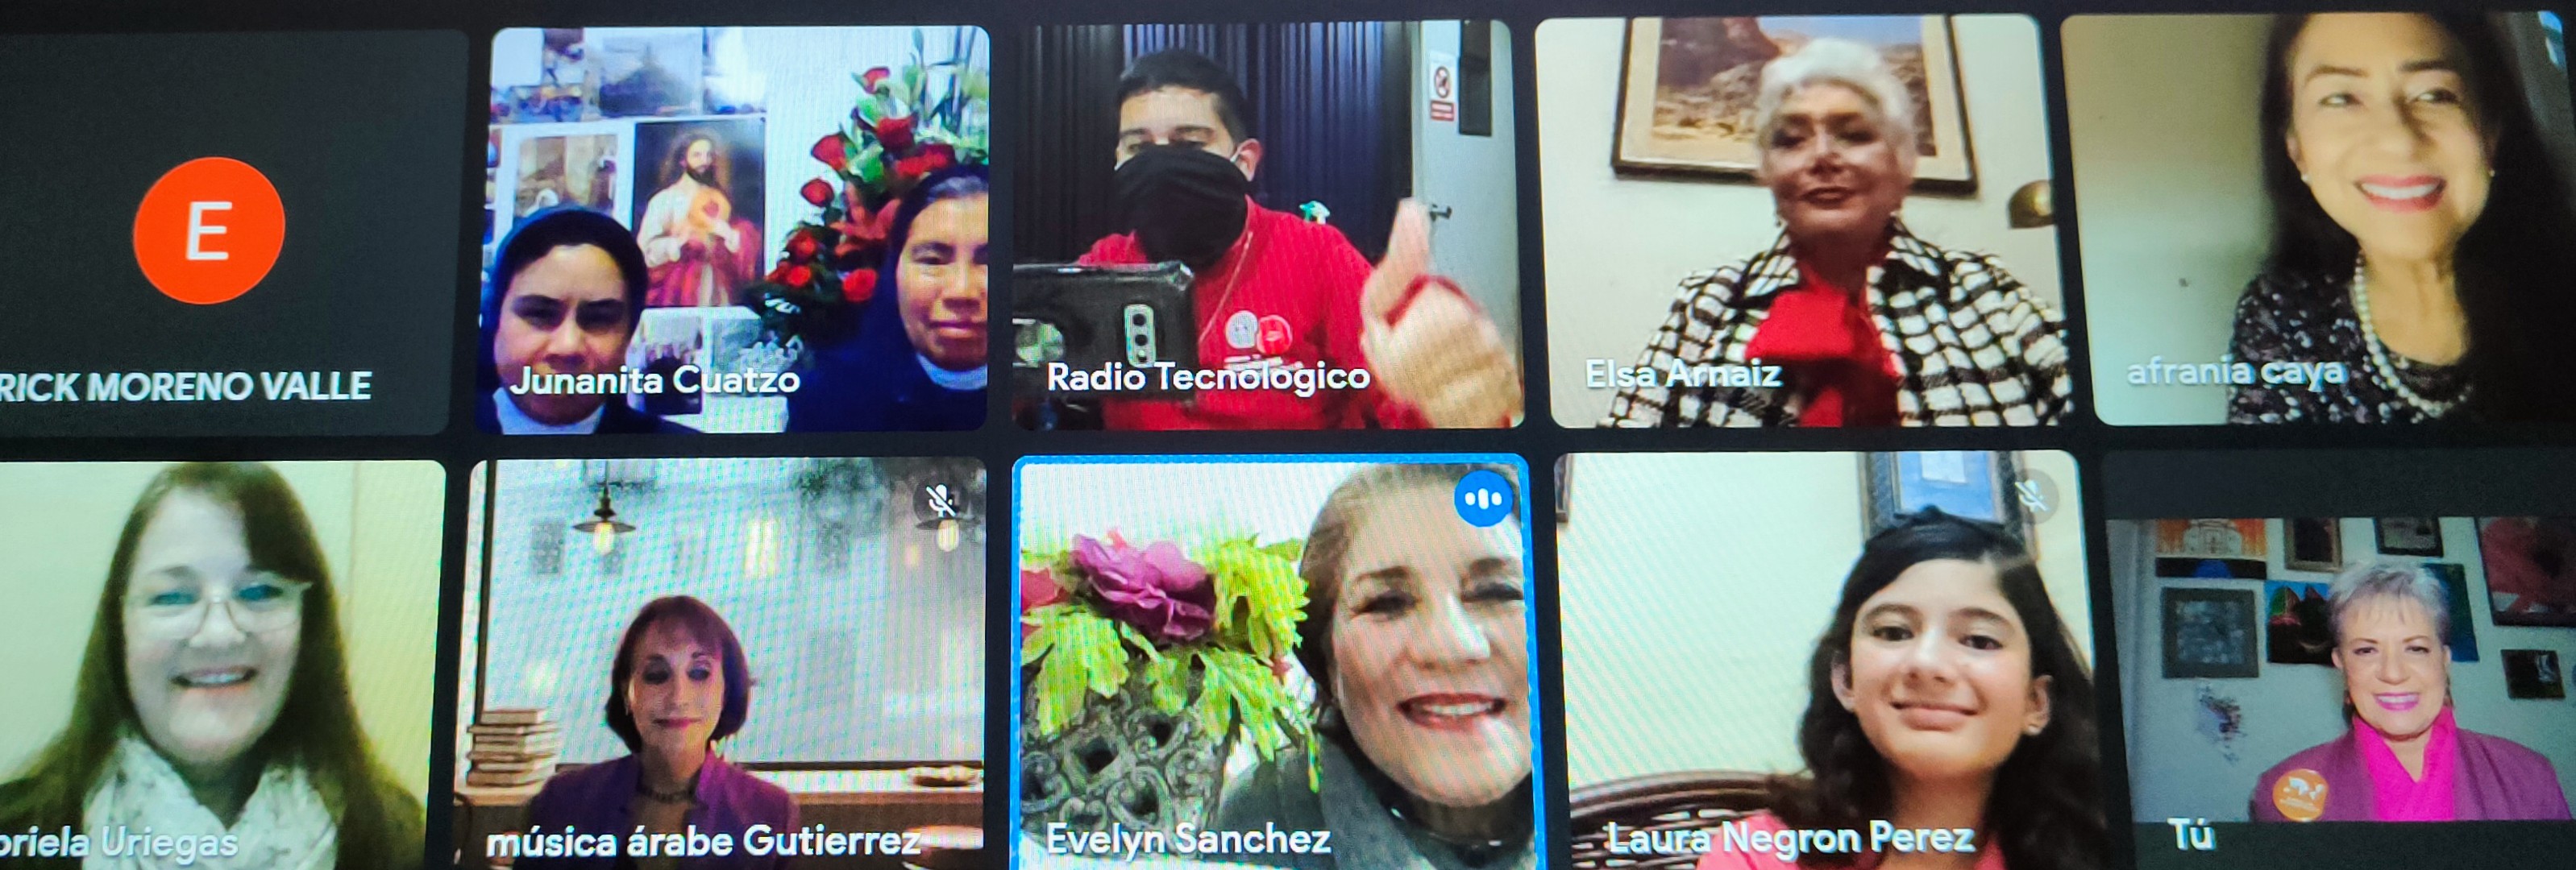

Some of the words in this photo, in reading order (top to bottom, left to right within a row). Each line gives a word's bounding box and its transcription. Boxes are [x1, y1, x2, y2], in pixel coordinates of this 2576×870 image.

[185, 200, 233, 261] E
[86, 371, 254, 401] MORENO
[260, 371, 373, 400] VALLE
[509, 365, 664, 396] Junanita
[672, 367, 801, 394] Cuatzo
[1047, 361, 1146, 392] Radio
[1153, 360, 1371, 398] Tecnologico
[1585, 358, 1657, 388] Elsa
[1664, 357, 1785, 387] Arnaiz
[2126, 354, 2256, 385] afrania
[2260, 361, 2348, 393] caya
[102, 825, 239, 866] Uriegas
[485, 825, 617, 859] música
[625, 825, 734, 858] árabe
[742, 823, 921, 856] Gutierrez
[1047, 822, 1165, 862] Evelyn
[1174, 821, 1332, 854] Sanchez
[1607, 821, 1712, 855] Laura
[1721, 821, 1862, 861] Negron
[1868, 819, 1976, 853] Perez
[2166, 817, 2217, 851] Tú
